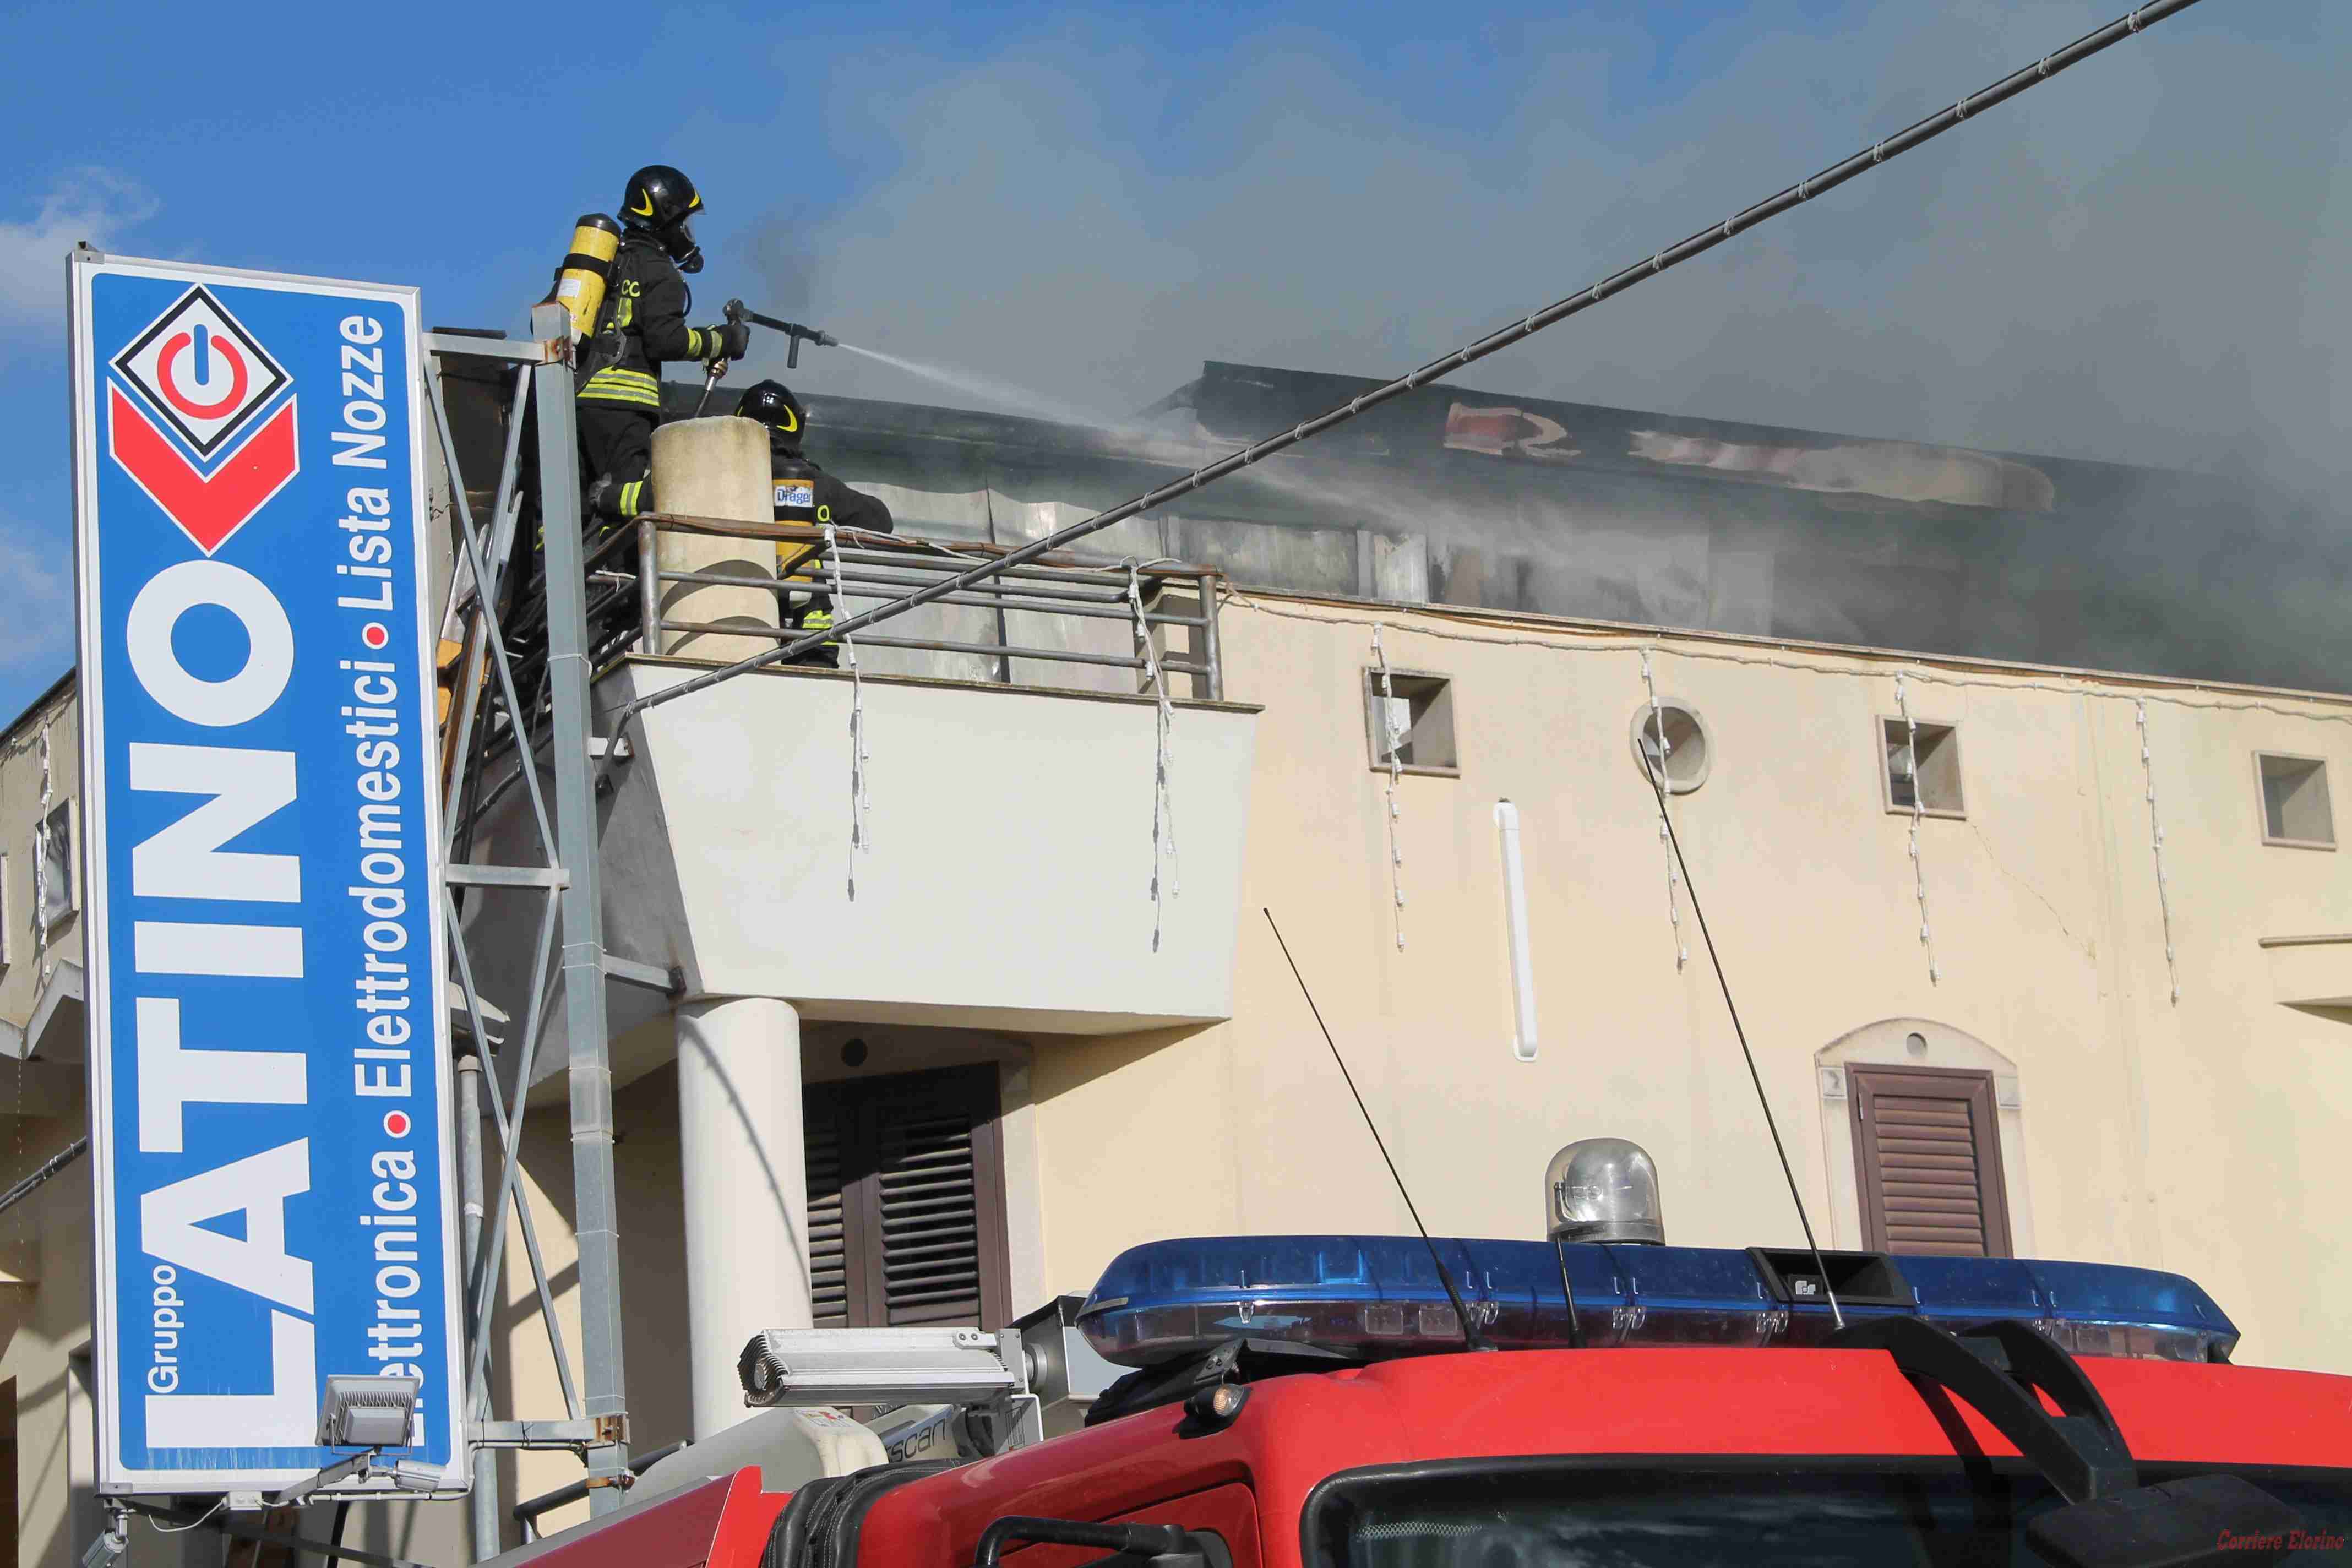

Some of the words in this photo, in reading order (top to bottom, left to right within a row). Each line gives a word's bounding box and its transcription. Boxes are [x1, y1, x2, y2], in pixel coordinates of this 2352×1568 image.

[331, 315, 387, 470] Nozze
[337, 487, 395, 612] Lista
[340, 660, 412, 1097] Elettrodomestici
[127, 559, 319, 1449] LATINO
[147, 1264, 185, 1395] Gruppo
[360, 1151, 425, 1447] ettronica
